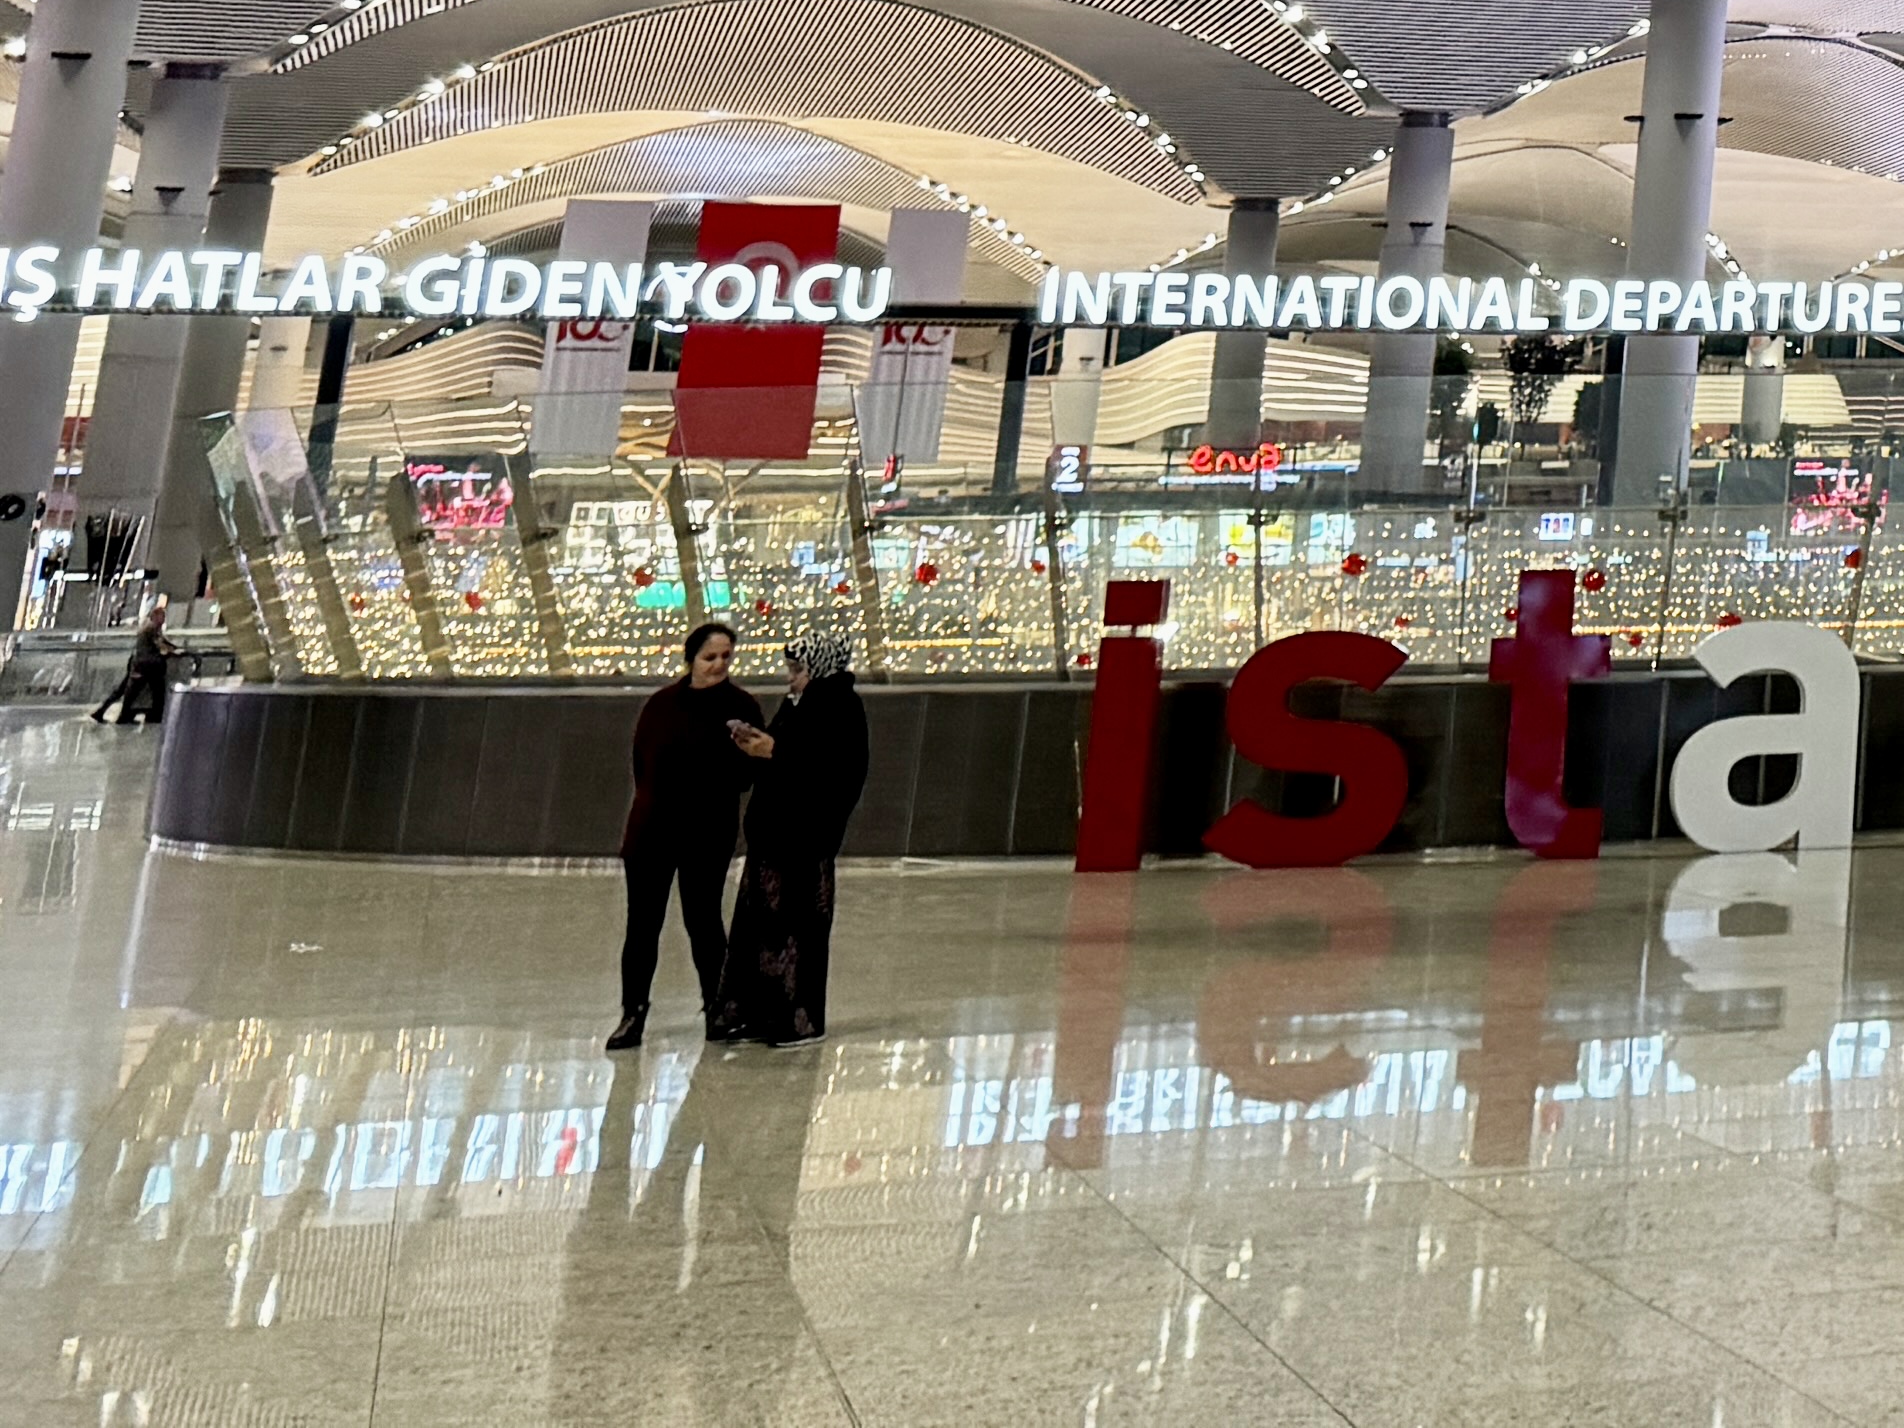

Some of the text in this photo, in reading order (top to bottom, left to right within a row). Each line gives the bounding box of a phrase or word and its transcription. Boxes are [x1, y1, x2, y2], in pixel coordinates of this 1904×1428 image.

[77, 247, 387, 314] HATLAR
[405, 241, 643, 320] GİDEN
[656, 260, 893, 323] YOLCU
[1040, 267, 1550, 331] INTERNATIONAL
[1055, 455, 1081, 484] 2
